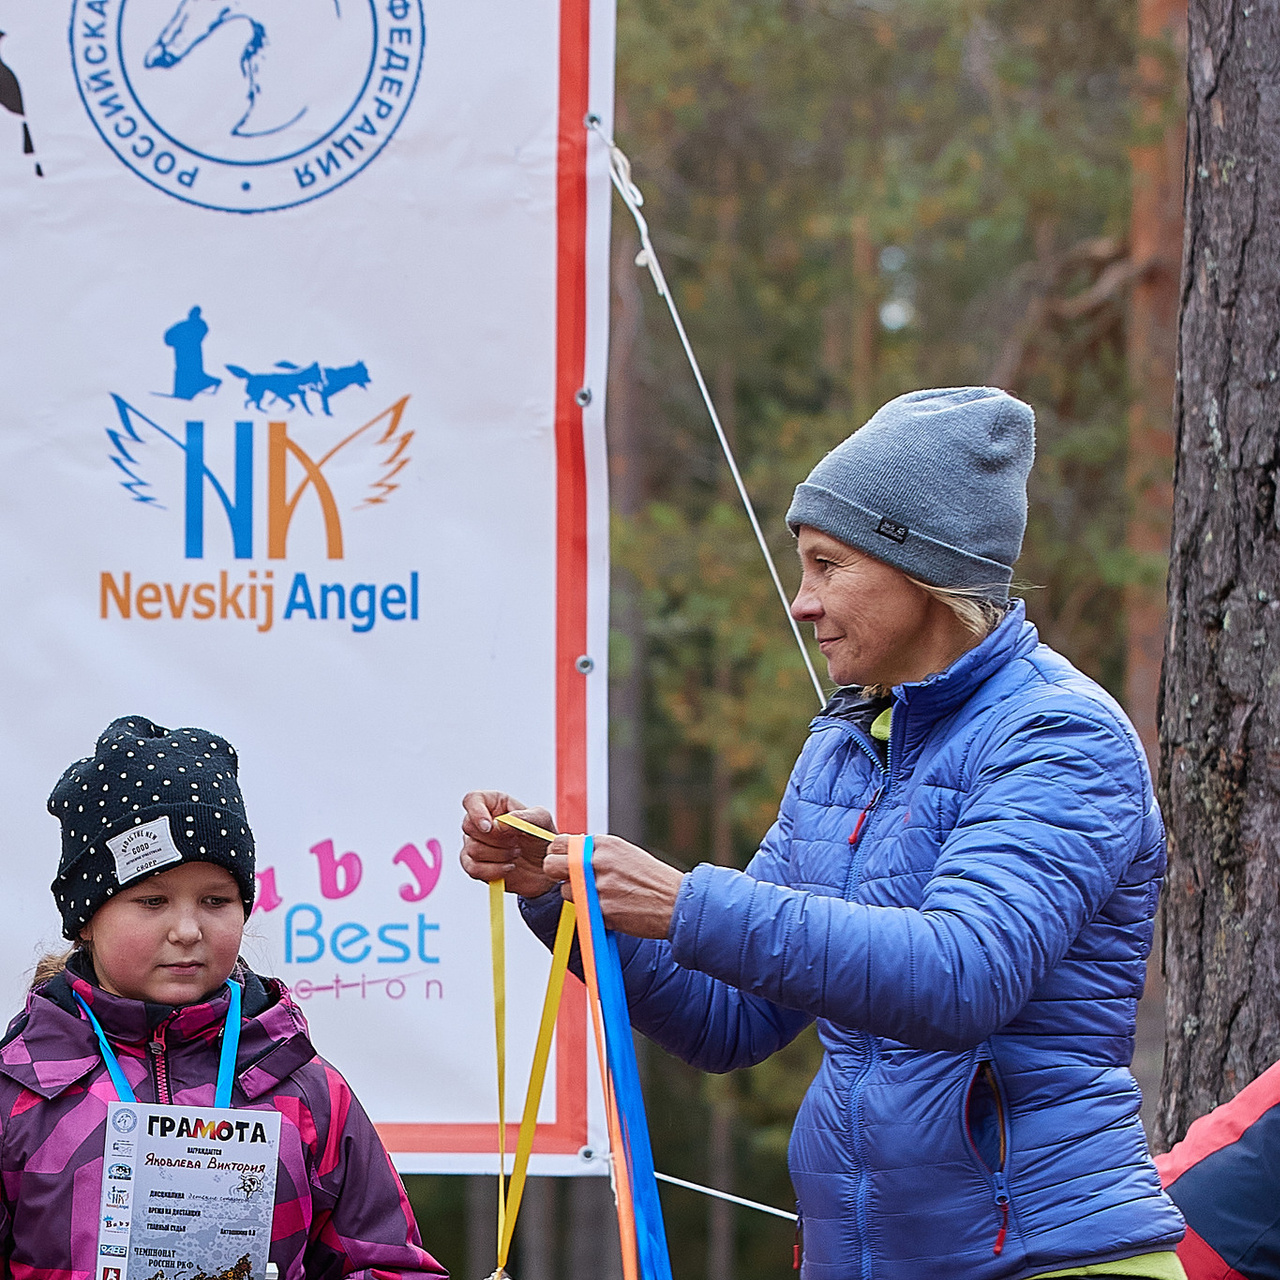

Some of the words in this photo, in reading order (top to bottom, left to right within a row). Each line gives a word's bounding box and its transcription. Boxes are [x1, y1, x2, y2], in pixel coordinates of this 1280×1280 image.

[294, 0, 412, 188] ФЕДЕРАЦИЯ
[100, 571, 275, 632] Nevskij
[283, 571, 419, 632] Angel
[131, 842, 150, 855] GOOD
[284, 903, 439, 964] Best
[147, 1115, 267, 1143] ГРАМОТА
[134, 1247, 176, 1258] ЧЕМПИОНАТ
[148, 1259, 176, 1268] РОССИИ
[176, 1261, 194, 1269] РКФ
